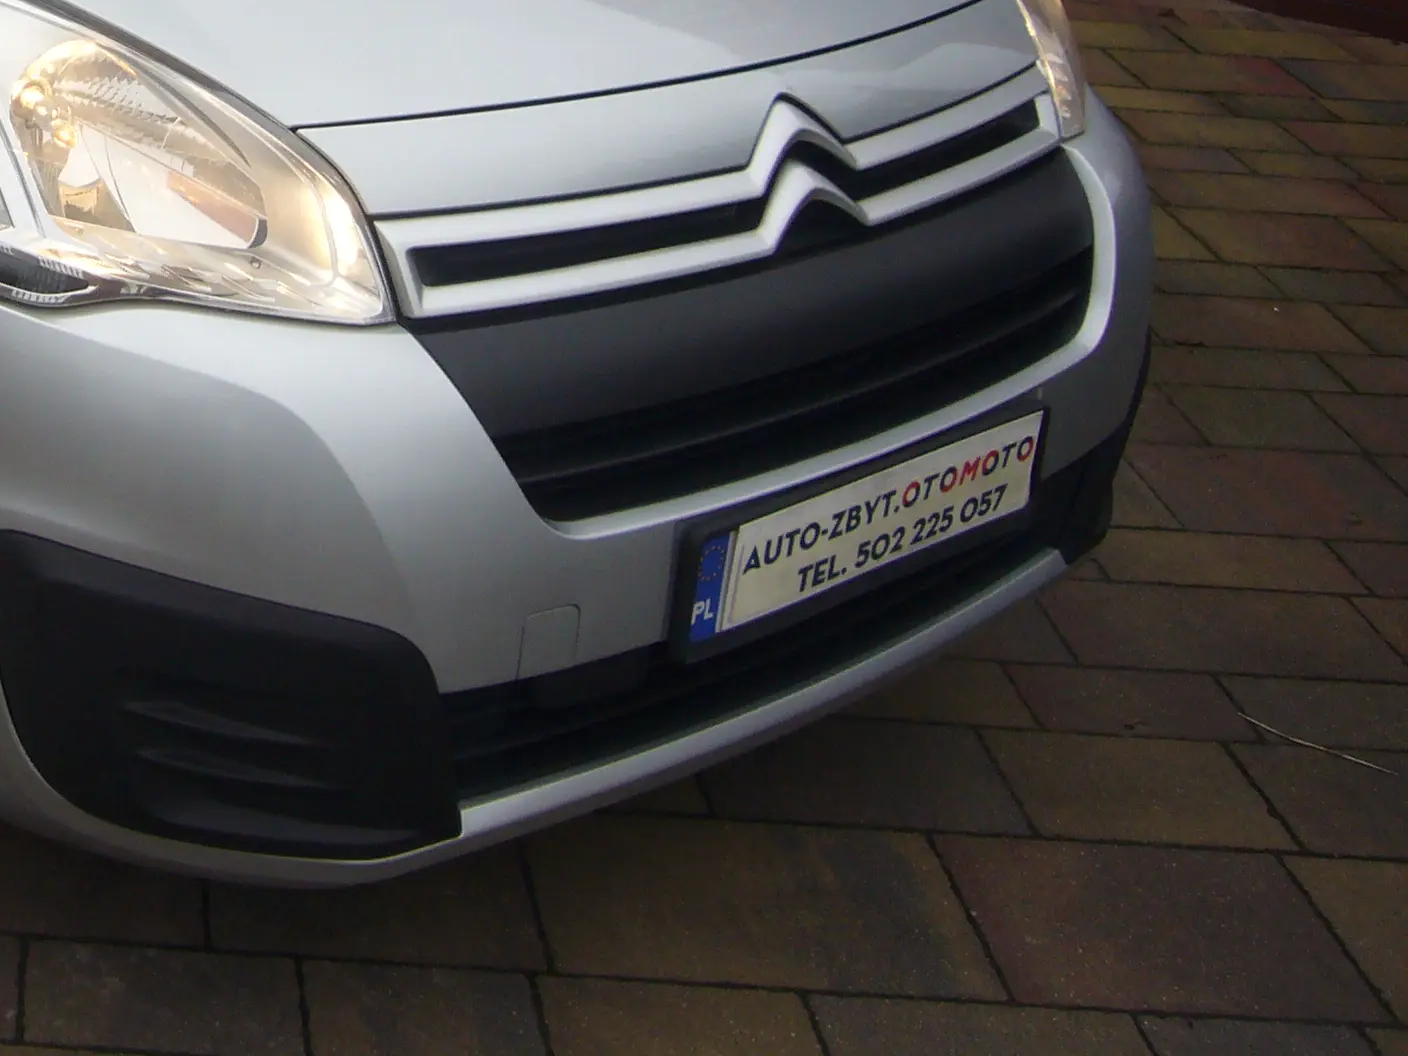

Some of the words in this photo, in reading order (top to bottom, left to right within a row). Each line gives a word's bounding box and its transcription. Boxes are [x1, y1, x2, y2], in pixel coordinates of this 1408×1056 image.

[741, 435, 1034, 575] AUTO-ZBYT.OTOMOTO
[798, 558, 847, 592] TEL.
[854, 527, 905, 569] 502
[910, 506, 953, 545] 225
[960, 484, 1008, 523] 057
[691, 599, 714, 625] PL
